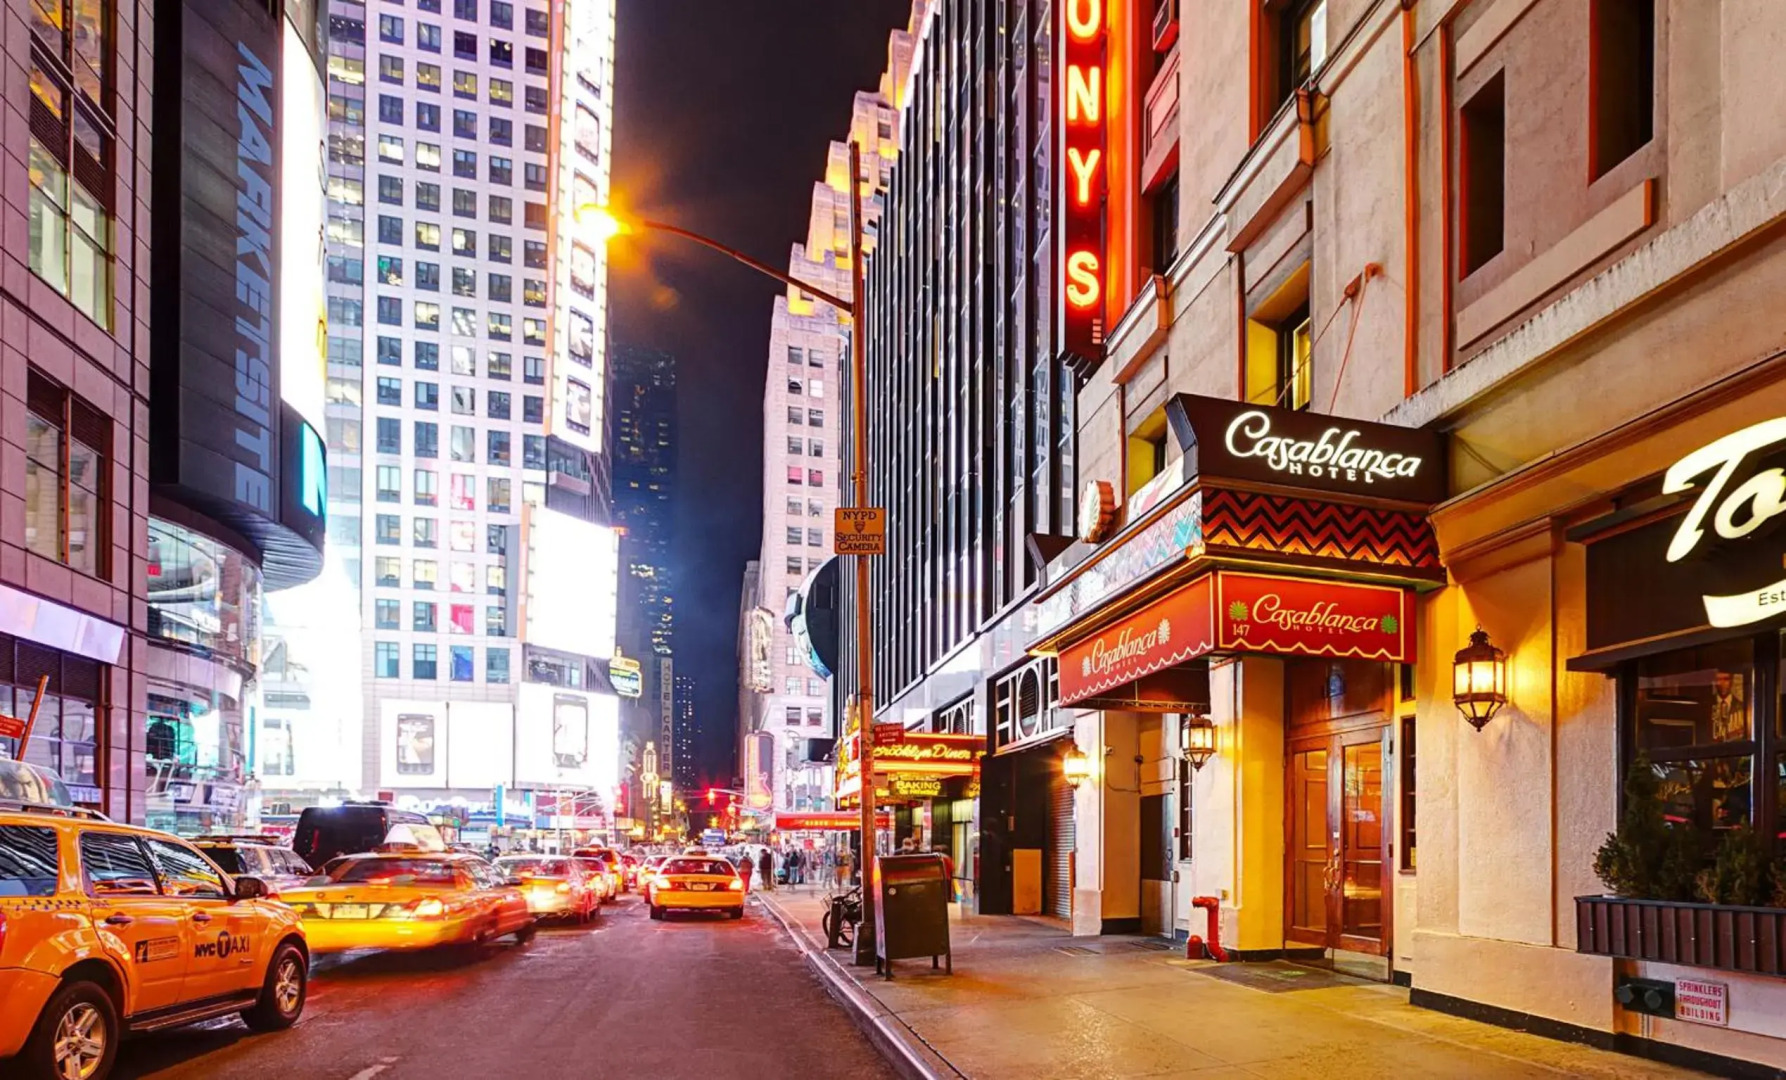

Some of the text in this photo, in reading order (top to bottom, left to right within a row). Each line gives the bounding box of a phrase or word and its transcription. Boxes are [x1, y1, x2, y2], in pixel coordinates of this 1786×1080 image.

[236, 40, 273, 512] MARKETSITE
[1225, 410, 1421, 478] Casablanca
[1289, 462, 1374, 483] HOTEL
[843, 511, 877, 520] NYPD
[839, 542, 880, 551] CAMERA
[1252, 593, 1378, 632] Casablanca
[1232, 623, 1250, 636] 147
[1293, 625, 1344, 635] HOTEL
[1091, 627, 1157, 674] Casablanca
[1110, 656, 1136, 672] HOTEL
[662, 715, 671, 771] CARTER
[932, 743, 971, 759] Diner
[896, 780, 941, 790] BAKING
[194, 943, 216, 958] NYC
